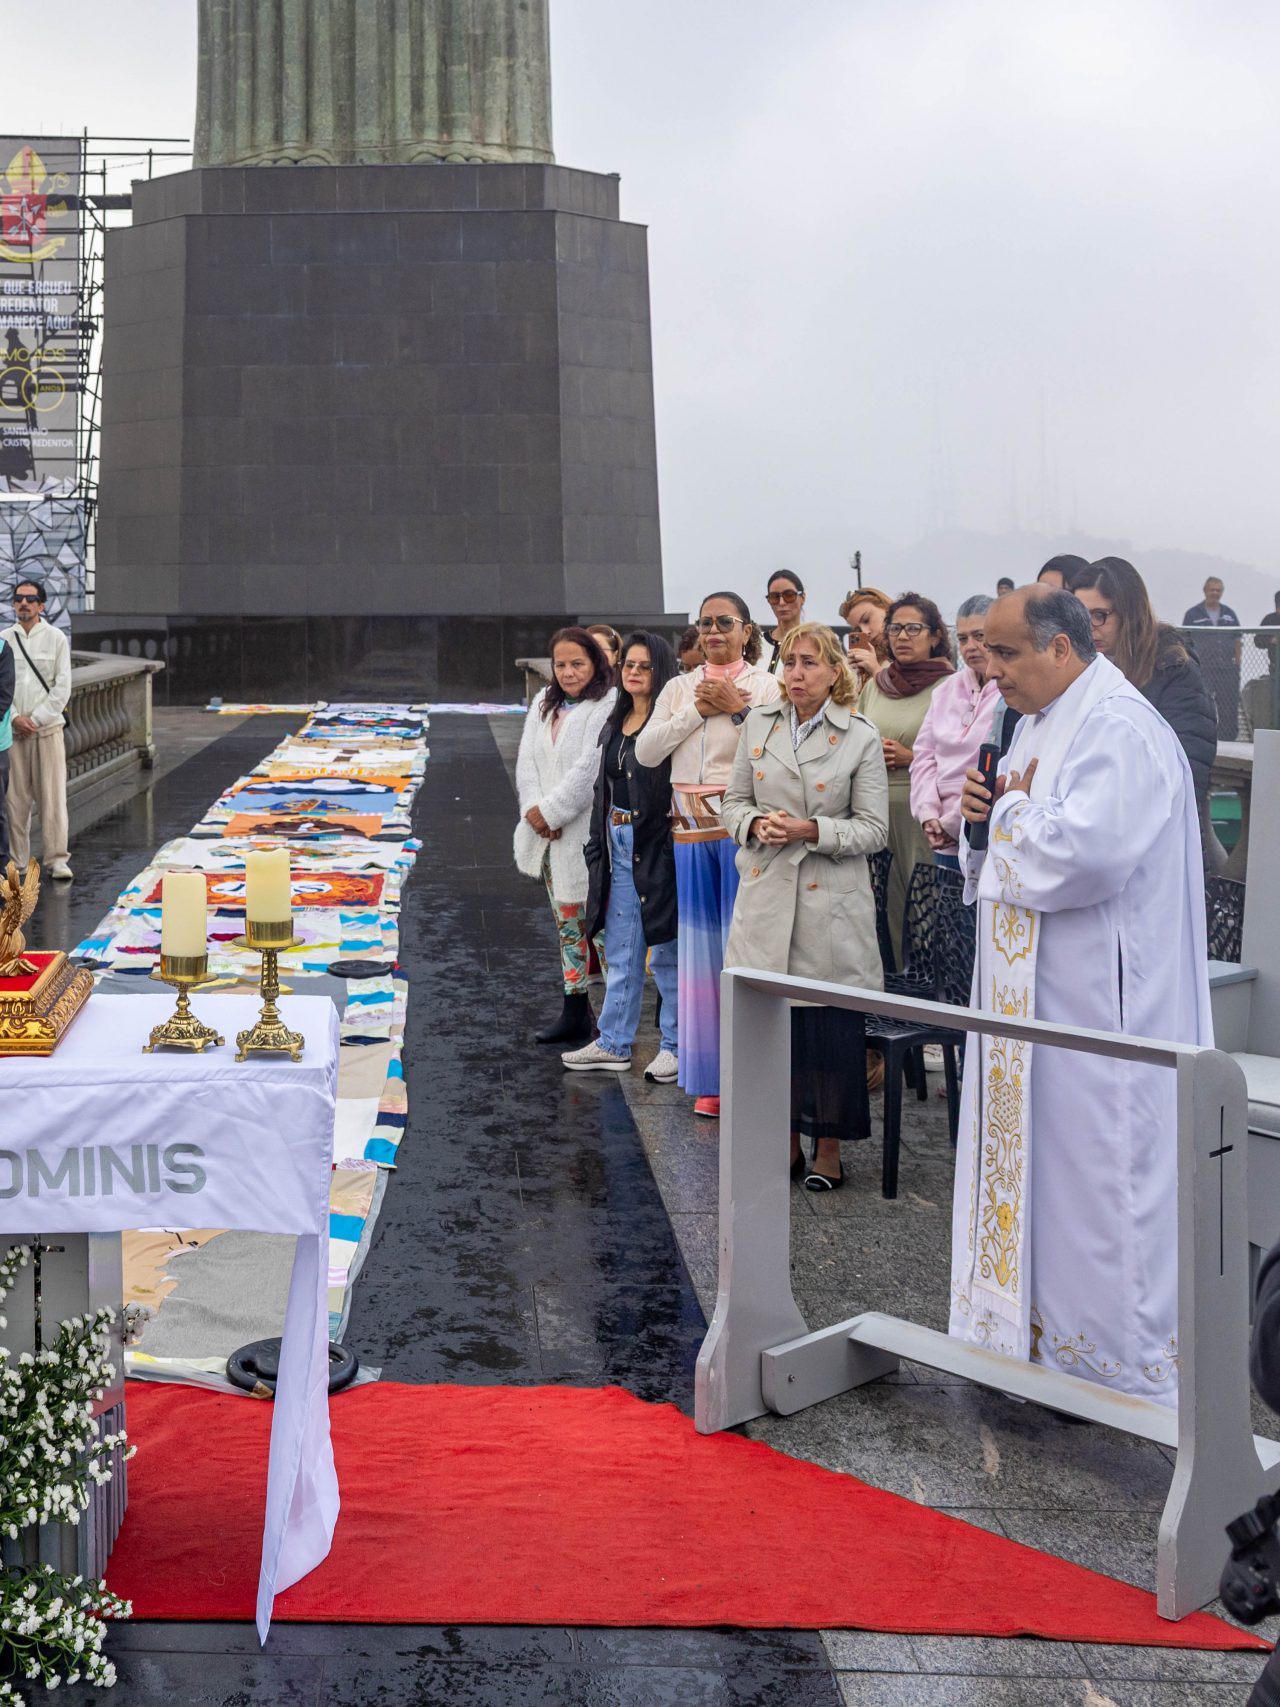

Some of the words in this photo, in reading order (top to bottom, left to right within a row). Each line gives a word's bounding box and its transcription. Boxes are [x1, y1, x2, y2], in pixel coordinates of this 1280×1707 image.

[4, 280, 25, 295] QUE
[28, 280, 72, 295] ERGUEU
[0, 297, 59, 313] REDENTOR
[46, 315, 72, 330] AQUI
[32, 347, 66, 362] AOS
[3, 438, 30, 448] CRISTO
[32, 438, 74, 448] REDENTOR
